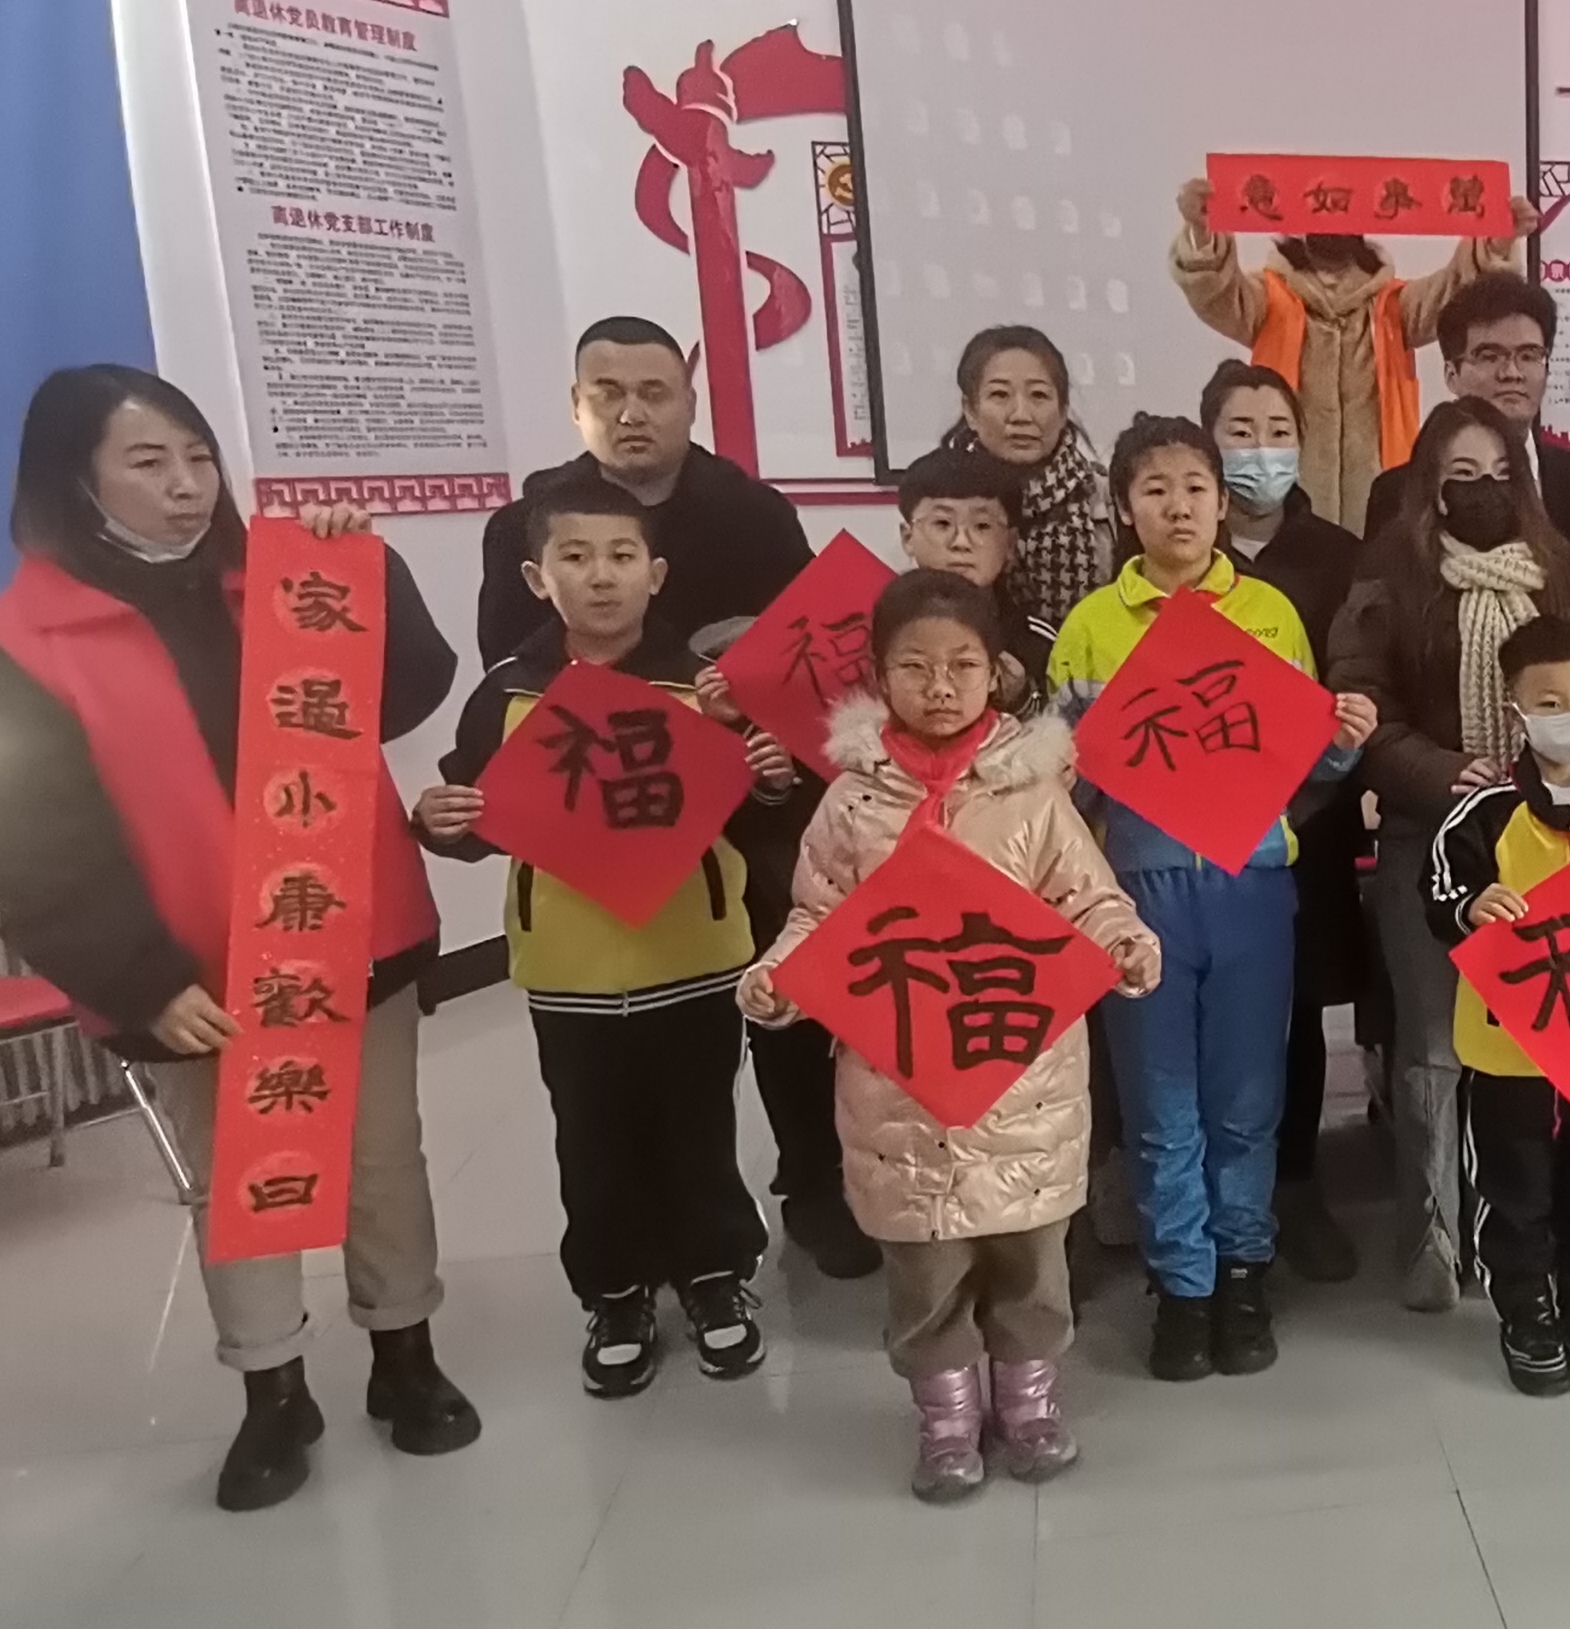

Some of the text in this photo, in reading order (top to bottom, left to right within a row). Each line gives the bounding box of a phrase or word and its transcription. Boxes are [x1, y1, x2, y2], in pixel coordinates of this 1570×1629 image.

[780, 612, 876, 708] 福
[1121, 660, 1260, 771] 福
[537, 704, 685, 831] 福
[847, 905, 1076, 1079] 福
